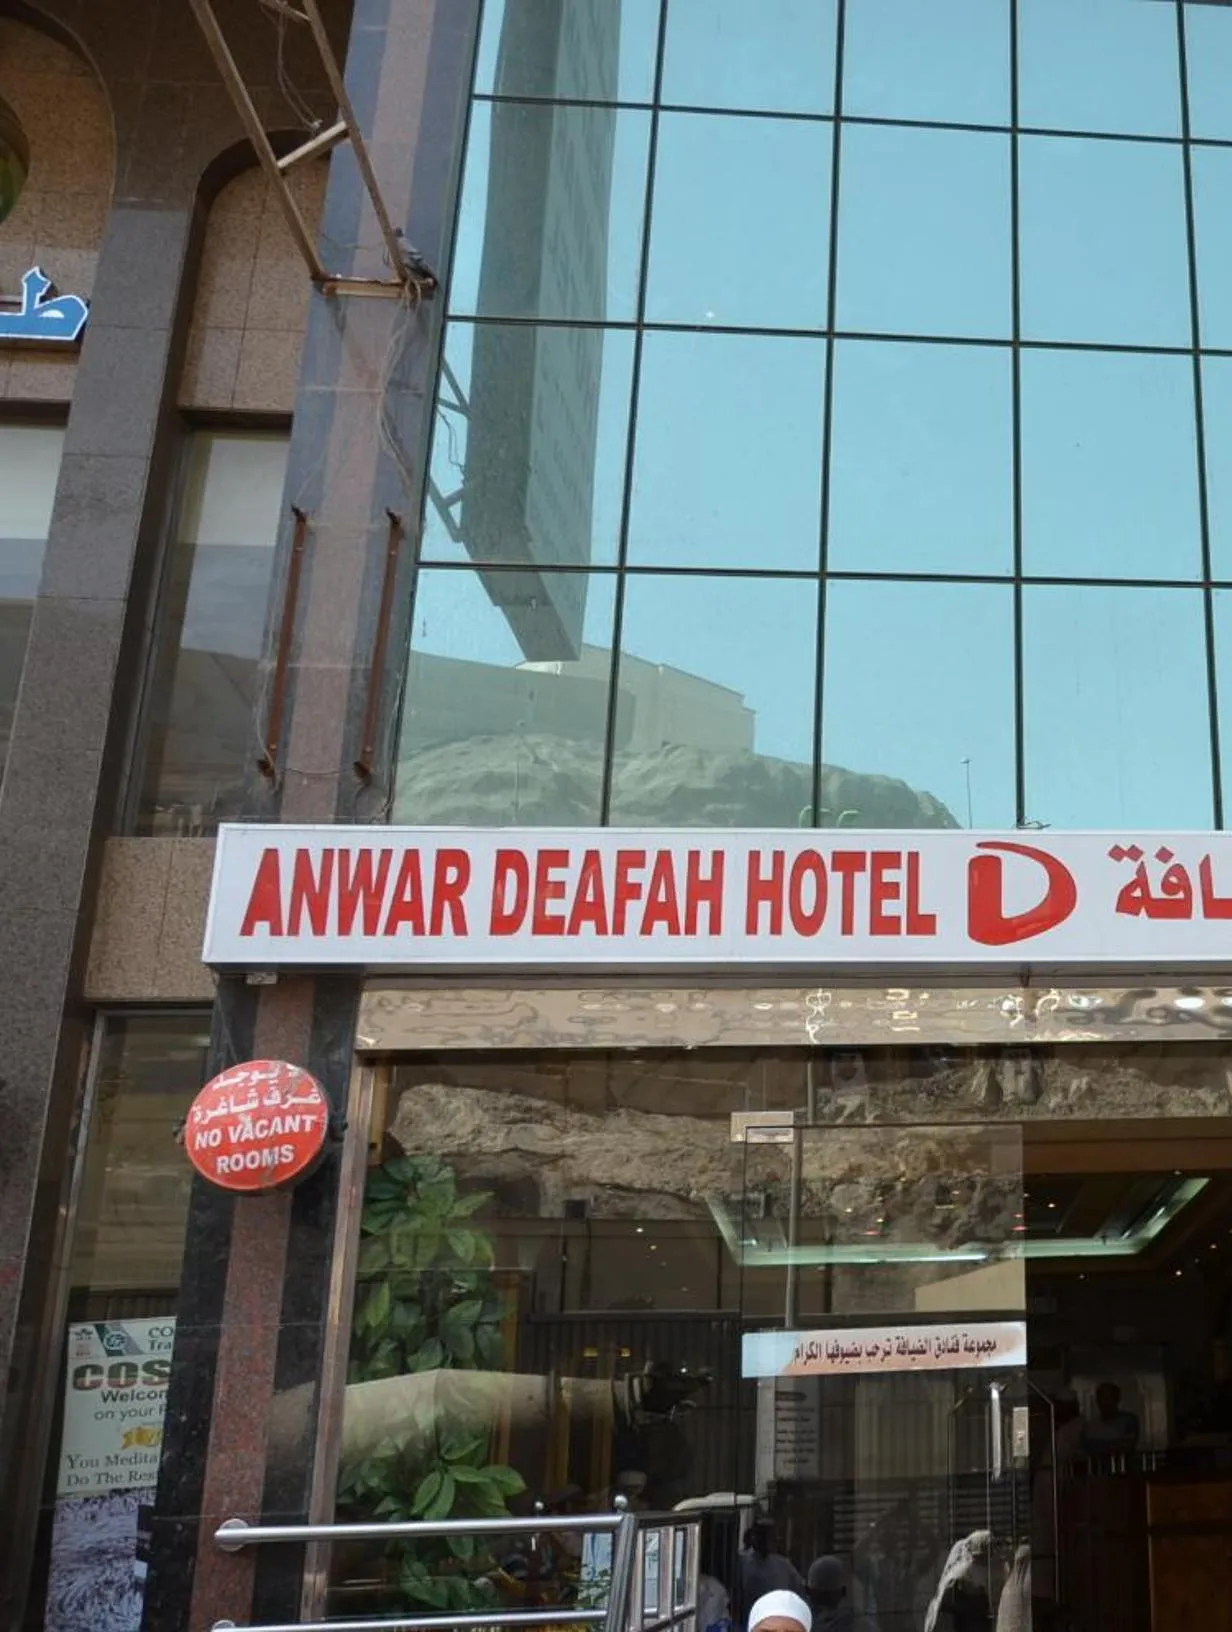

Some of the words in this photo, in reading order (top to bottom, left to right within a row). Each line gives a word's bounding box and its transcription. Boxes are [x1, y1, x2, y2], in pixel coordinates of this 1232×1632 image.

[240, 848, 471, 937] ANWAR
[489, 849, 725, 937] DEAFAH
[745, 848, 937, 937] HOTEL
[191, 1086, 260, 1125] شاغرة
[195, 1129, 222, 1151] NO
[228, 1115, 317, 1144] VACANT
[216, 1144, 295, 1174] ROOMS
[94, 1410, 115, 1420] on
[120, 1406, 155, 1422] your
[66, 1453, 99, 1469] You
[67, 1474, 89, 1487] Do
[95, 1471, 122, 1485] The
